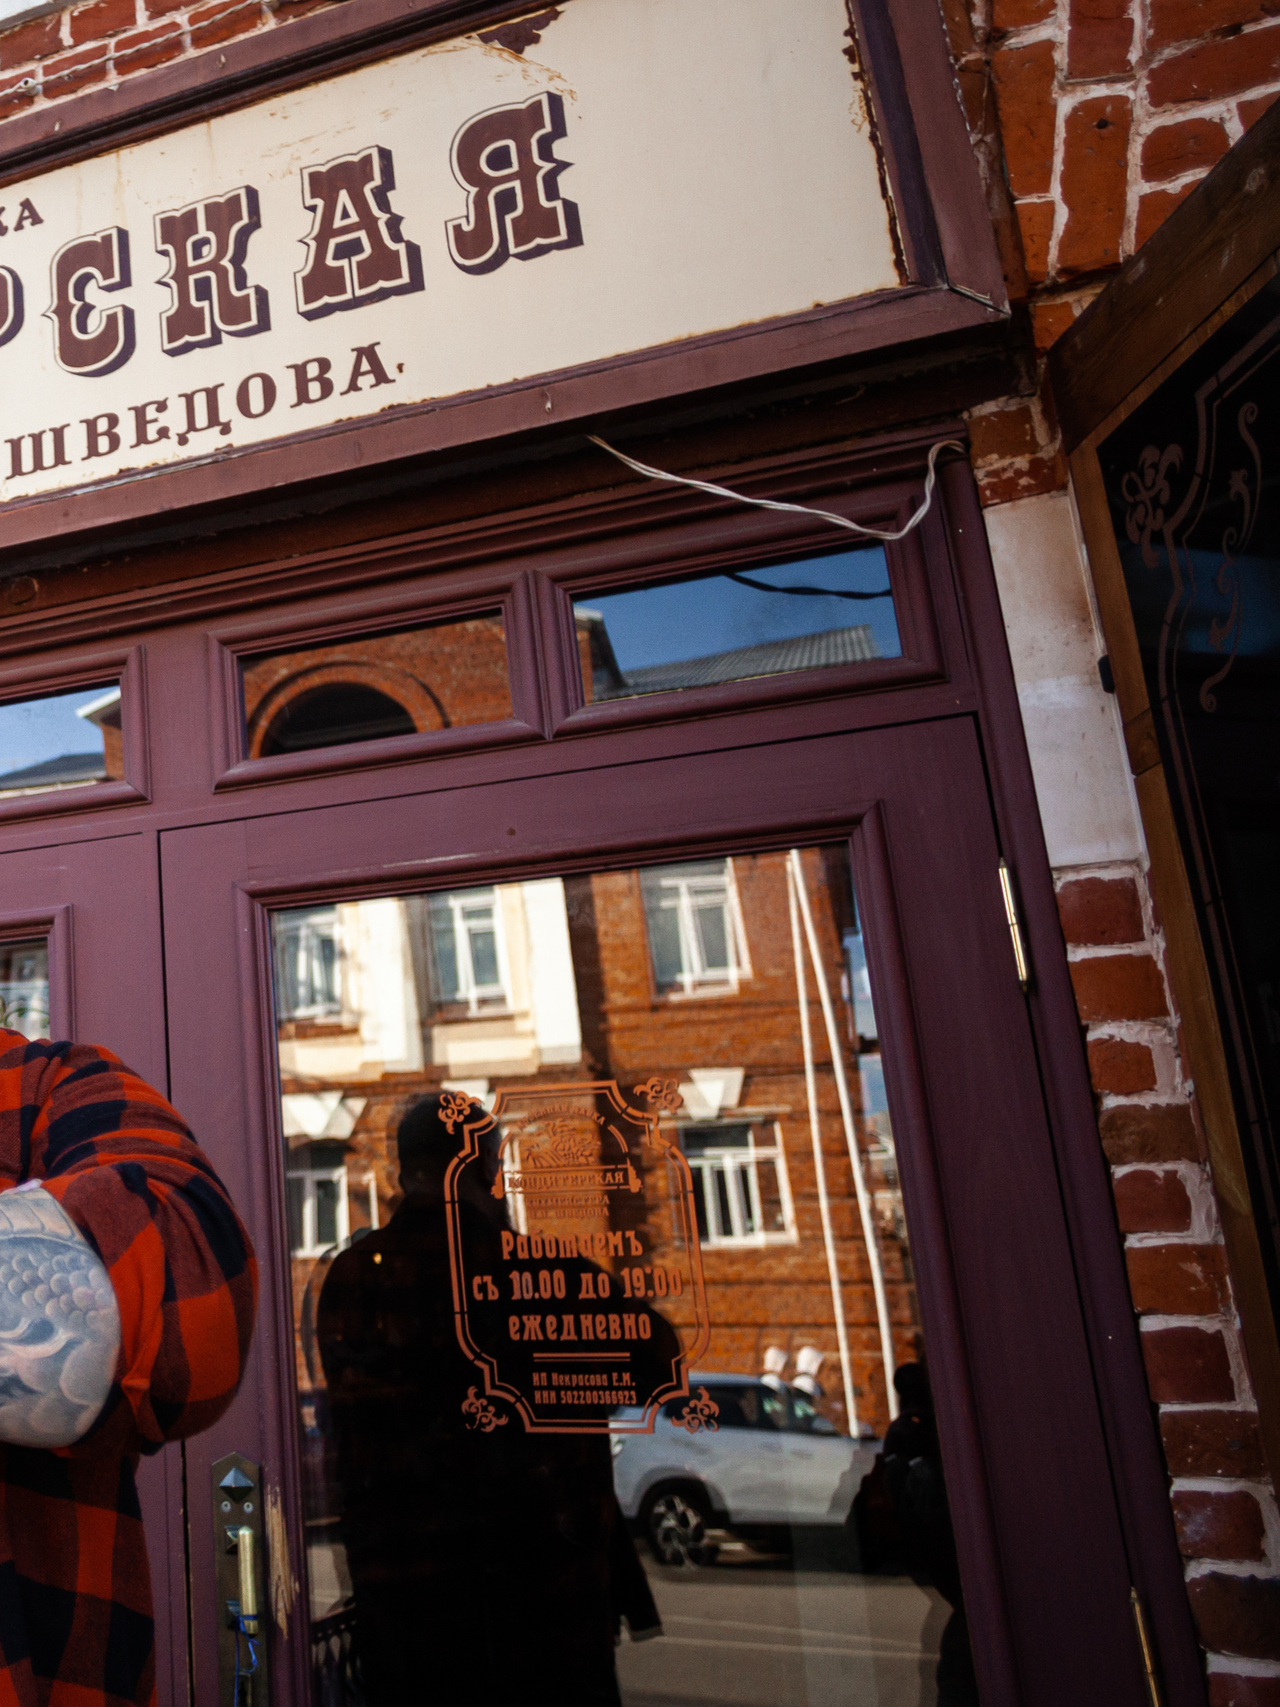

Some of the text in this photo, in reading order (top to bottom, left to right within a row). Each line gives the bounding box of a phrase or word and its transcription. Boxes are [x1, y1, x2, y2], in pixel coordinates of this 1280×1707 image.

[508, 1268, 567, 1300] 10.00
[578, 1272, 611, 1300] до
[508, 1312, 652, 1342] ежедневно
